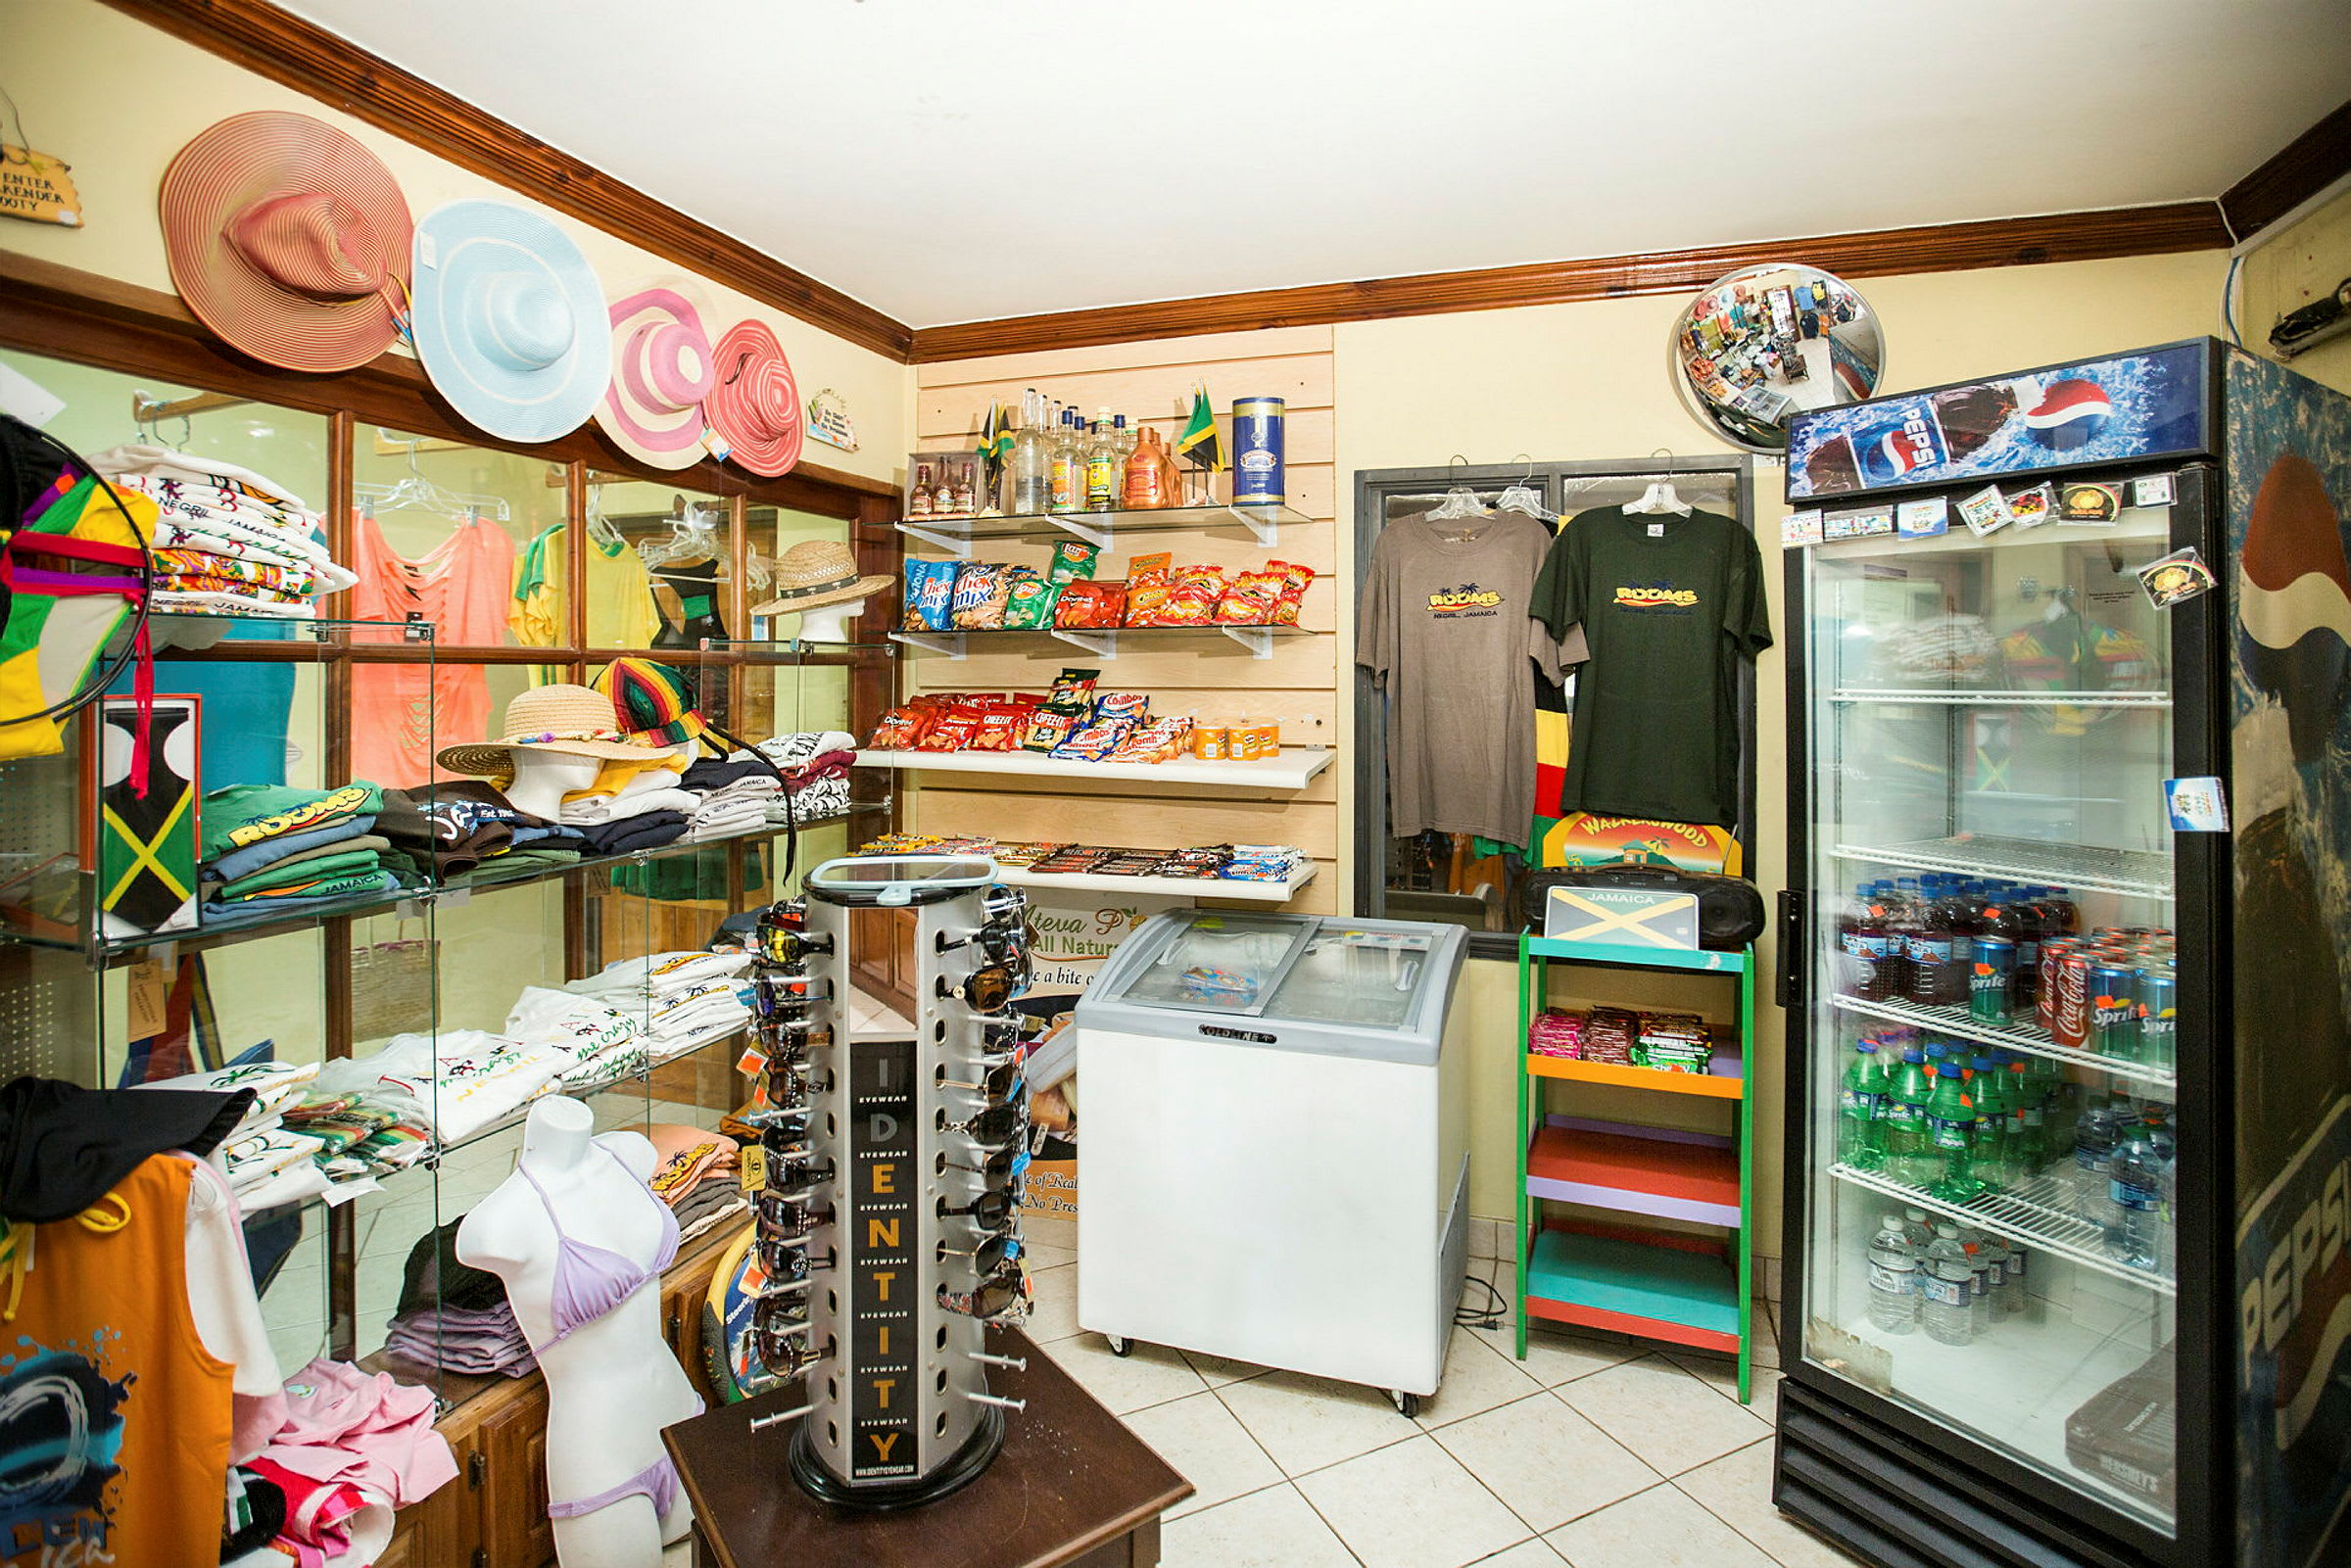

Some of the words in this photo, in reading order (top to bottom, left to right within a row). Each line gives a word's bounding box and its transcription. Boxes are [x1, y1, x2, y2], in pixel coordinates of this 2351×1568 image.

[3, 172, 55, 191] ENTER
[0, 185, 65, 205] RENDER
[1899, 407, 1938, 468] PEPSI
[1429, 591, 1502, 606] ROOMS
[1615, 587, 1698, 602] ROOMS
[227, 787, 366, 847] ROOMS
[320, 874, 384, 895] JAMAICA
[1587, 892, 1655, 905] JAMAICA
[1057, 966, 1082, 985] bite
[1969, 974, 2007, 993] Sprite
[2056, 959, 2087, 1039] Coca-Cola
[859, 1095, 908, 1104] EYEWEAR
[1048, 1172, 1078, 1189] Real
[860, 1203, 908, 1212] EYEWEAR
[2242, 1157, 2351, 1391] PEPSI
[860, 1310, 908, 1319] EYEWEAR
[860, 1418, 908, 1427] EYEWEAR
